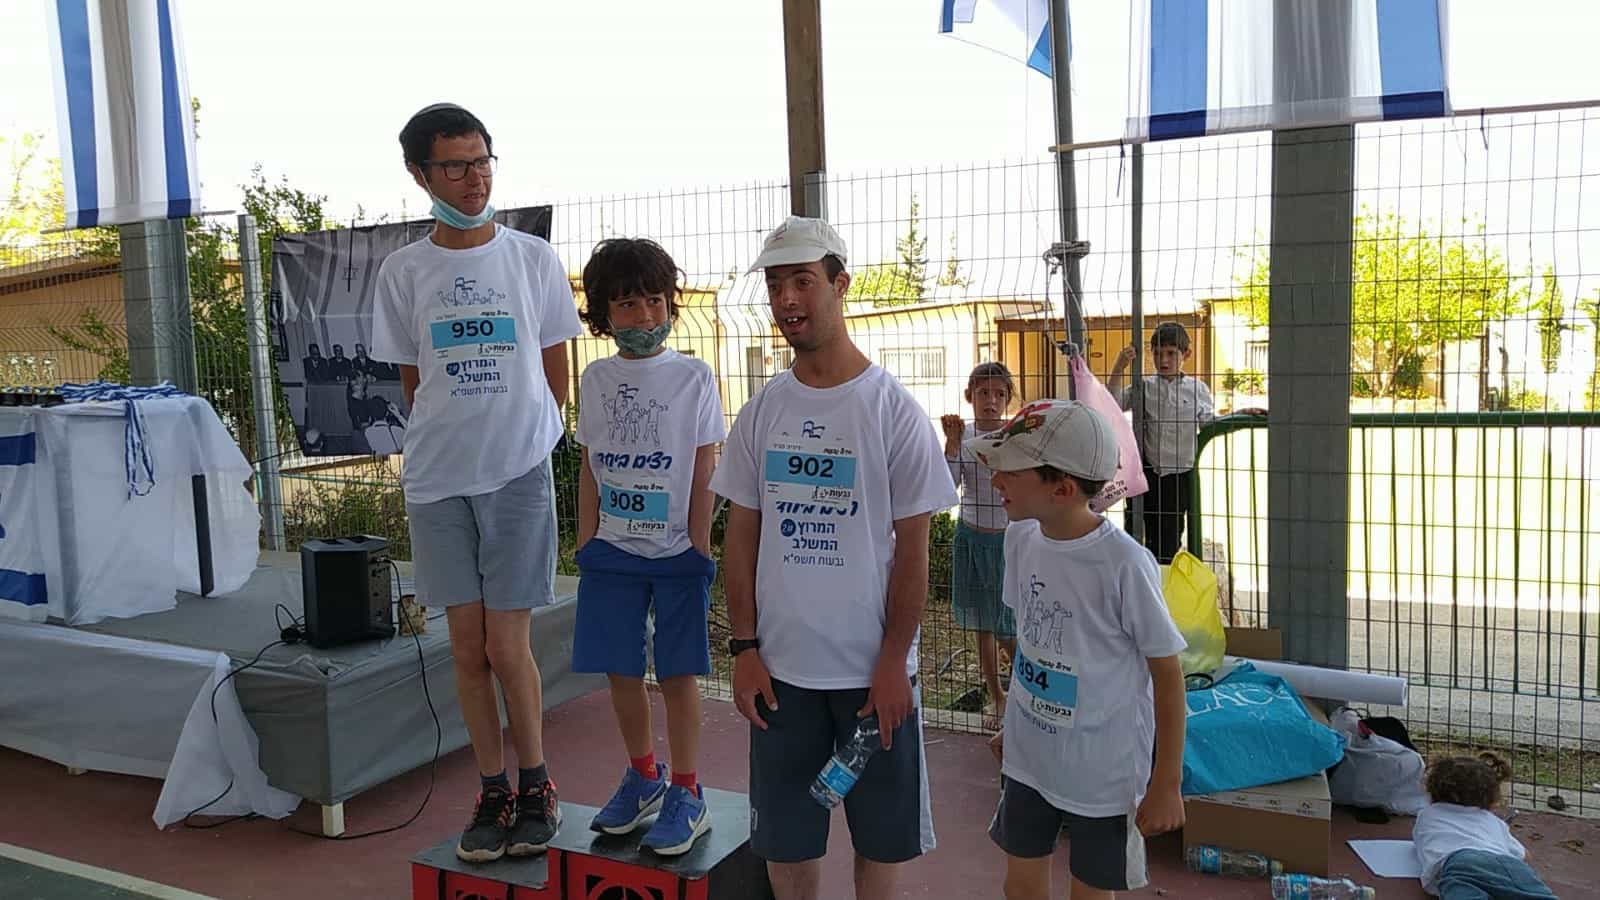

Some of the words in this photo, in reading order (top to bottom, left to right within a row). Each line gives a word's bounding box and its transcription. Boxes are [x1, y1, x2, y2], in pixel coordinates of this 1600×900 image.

[452, 320, 494, 339] 950
[461, 358, 496, 371] המרוץ
[458, 371, 501, 384] המשלב
[484, 385, 509, 394] גבעות
[632, 451, 672, 470] רצים
[788, 455, 834, 478] 902
[610, 491, 645, 512] 908
[798, 521, 836, 535] המרוץ
[792, 536, 838, 551] המשלב
[818, 556, 845, 567] גבעות
[1045, 703, 1072, 717] גבעות
